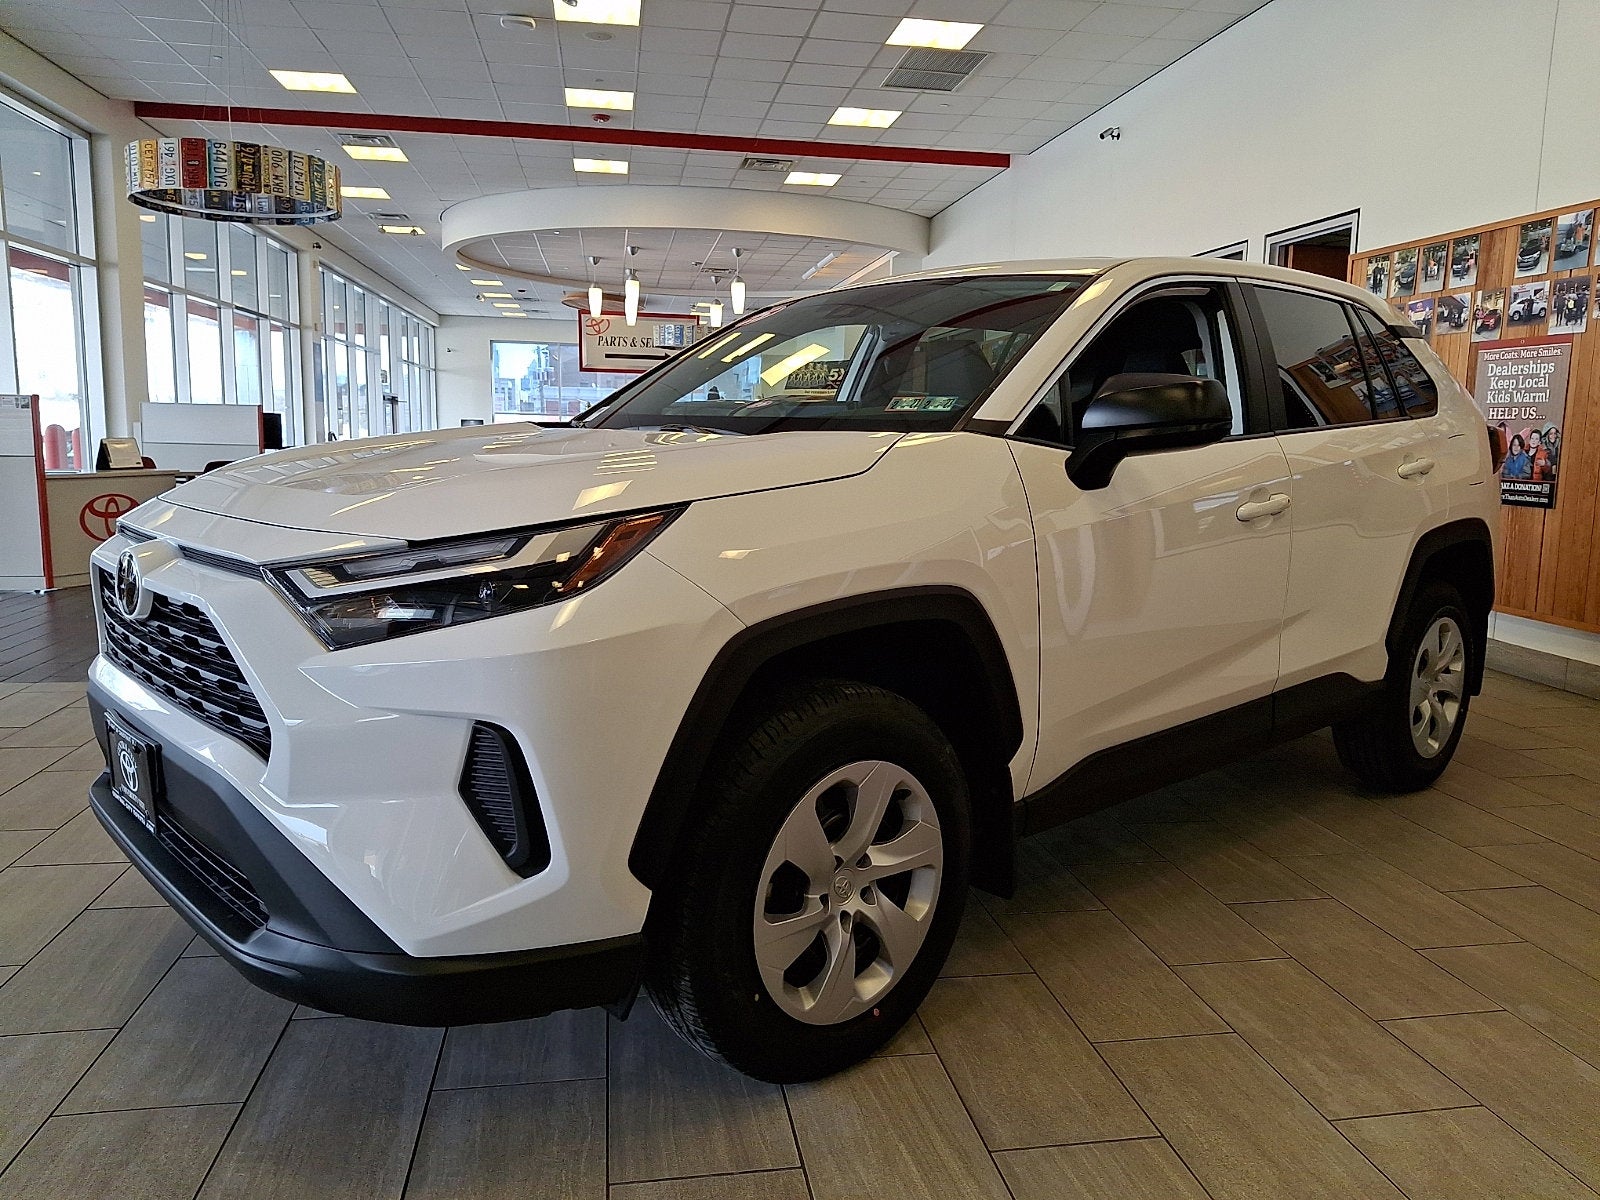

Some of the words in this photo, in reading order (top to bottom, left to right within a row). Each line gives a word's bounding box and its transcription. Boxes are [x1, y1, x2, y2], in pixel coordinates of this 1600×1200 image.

[163, 142, 175, 158] 461
[271, 150, 283, 169] 900
[165, 167, 176, 186] UXG
[598, 335, 628, 347] PARTS
[629, 336, 638, 348] &
[1483, 352, 1500, 361] More
[1500, 351, 1520, 360] Coats.
[1520, 349, 1538, 359] More
[1538, 346, 1563, 357] Smiles.
[1487, 359, 1555, 377] Dealerships
[1489, 376, 1517, 392] Keep
[1518, 373, 1549, 389] Local
[1486, 390, 1511, 404] Kids
[1512, 388, 1550, 403] Warm!
[1488, 406, 1519, 420] HELP
[1520, 406, 1546, 420] US...
